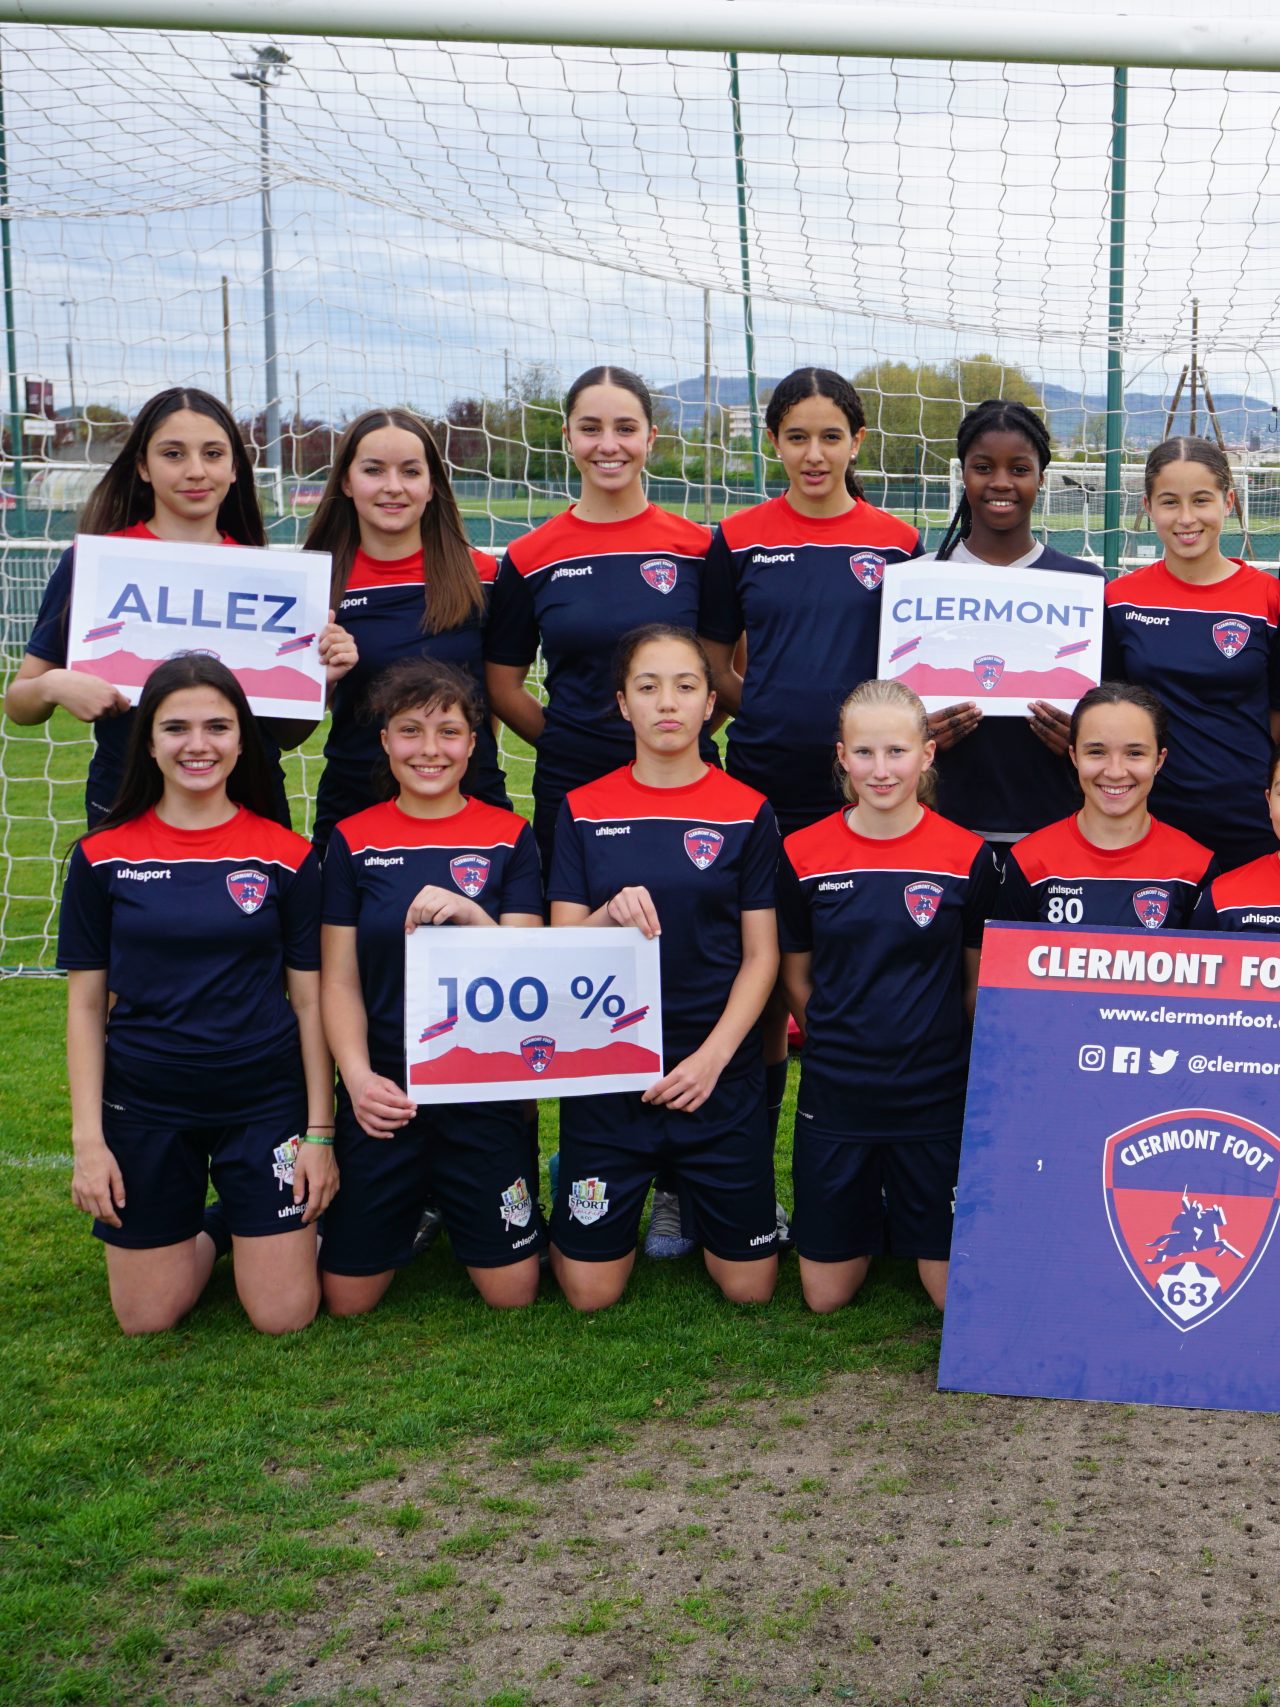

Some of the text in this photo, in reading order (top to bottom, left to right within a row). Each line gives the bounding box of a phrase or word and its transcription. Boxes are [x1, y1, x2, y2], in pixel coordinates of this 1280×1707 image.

[107, 583, 297, 634] ALLEZ
[892, 597, 1094, 627] CLERMONT
[1125, 611, 1170, 625] uhlsport
[595, 825, 631, 837] uhlsport
[364, 856, 404, 867] uhlsport
[117, 868, 171, 882] uhlsport
[818, 880, 854, 891] uhlsport
[1047, 884, 1083, 896] uhlsport
[1047, 897, 1084, 924] 80
[1028, 945, 1222, 985] CLERMONT
[438, 975, 626, 1022] 100 %
[1120, 1129, 1274, 1172] CLERMONT FOOT
[570, 1197, 606, 1210] SPORT
[1167, 1281, 1207, 1307] 63
